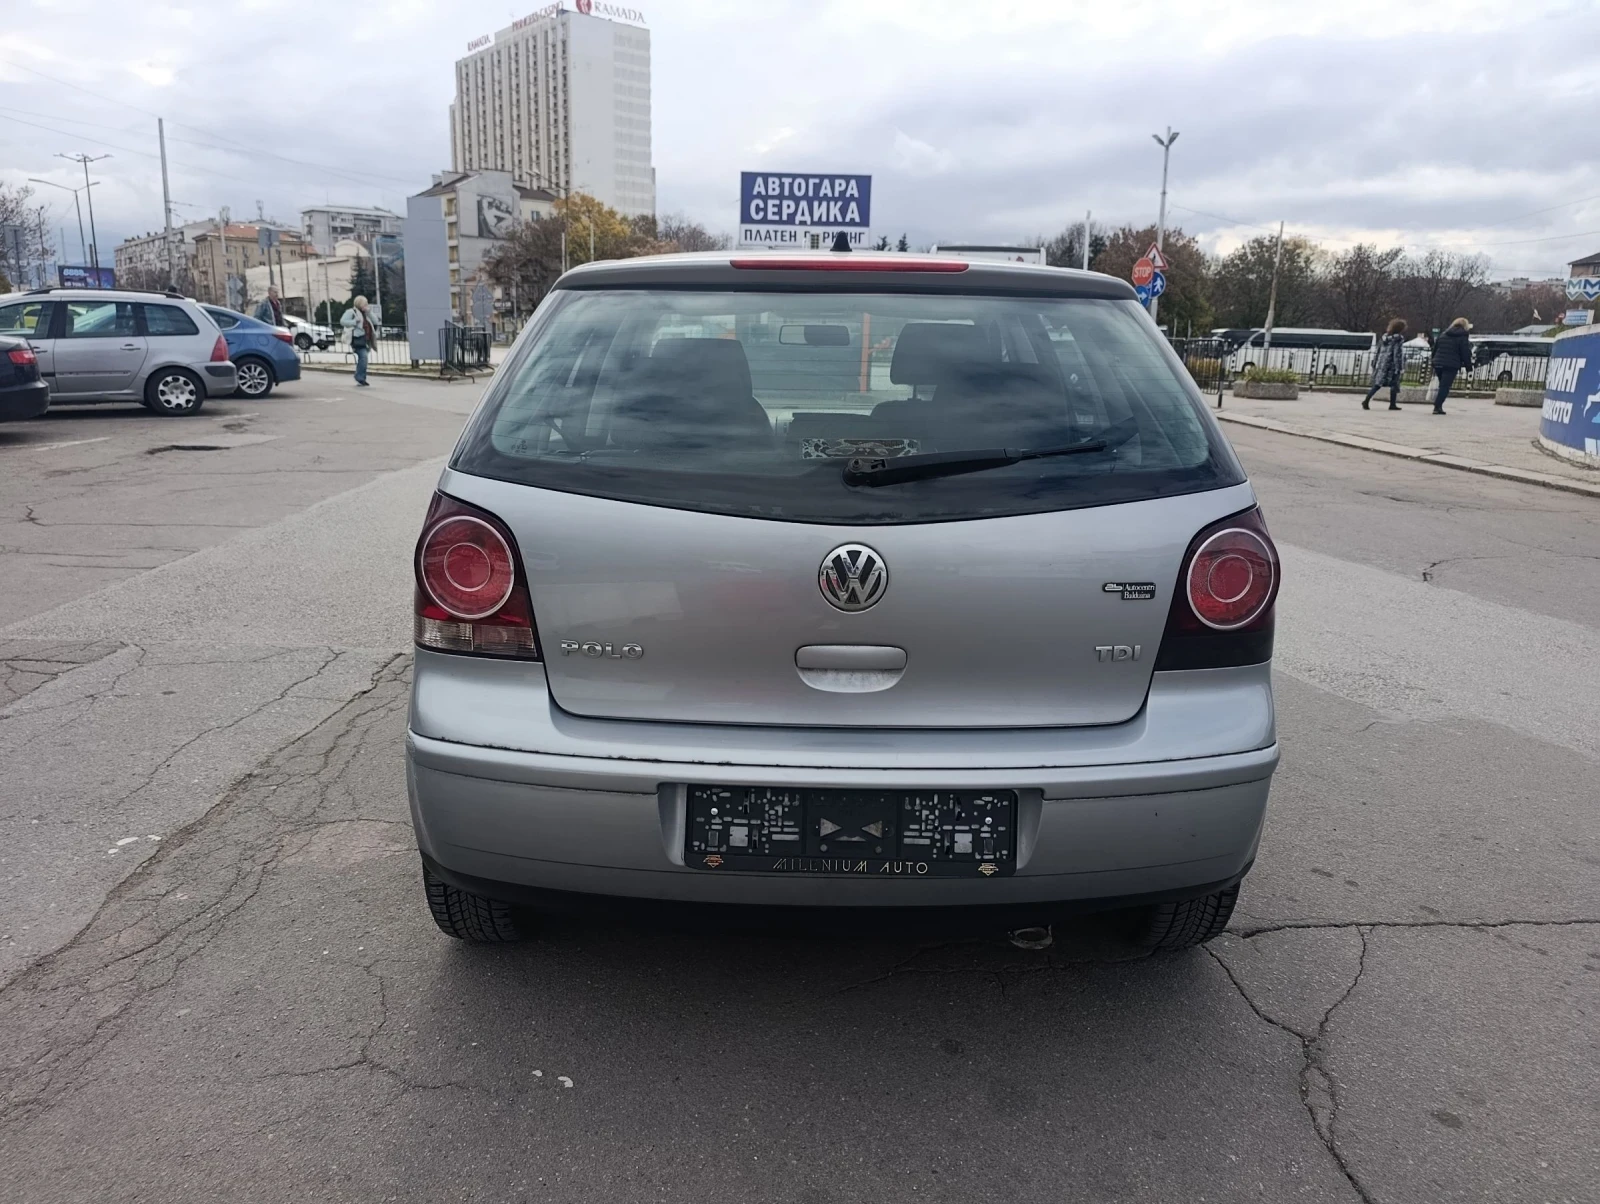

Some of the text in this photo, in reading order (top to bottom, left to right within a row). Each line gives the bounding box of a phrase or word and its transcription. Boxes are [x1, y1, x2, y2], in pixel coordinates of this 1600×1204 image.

[594, 1, 646, 24] RAMADA
[752, 176, 859, 198] АВТОГАРА
[750, 198, 860, 225] СЕРДИКА
[744, 229, 797, 242] ПЛАТЕН
[1134, 266, 1151, 278] STOP
[561, 639, 644, 660] POLO
[1095, 645, 1142, 662] TDI
[879, 861, 929, 874] AUTO
